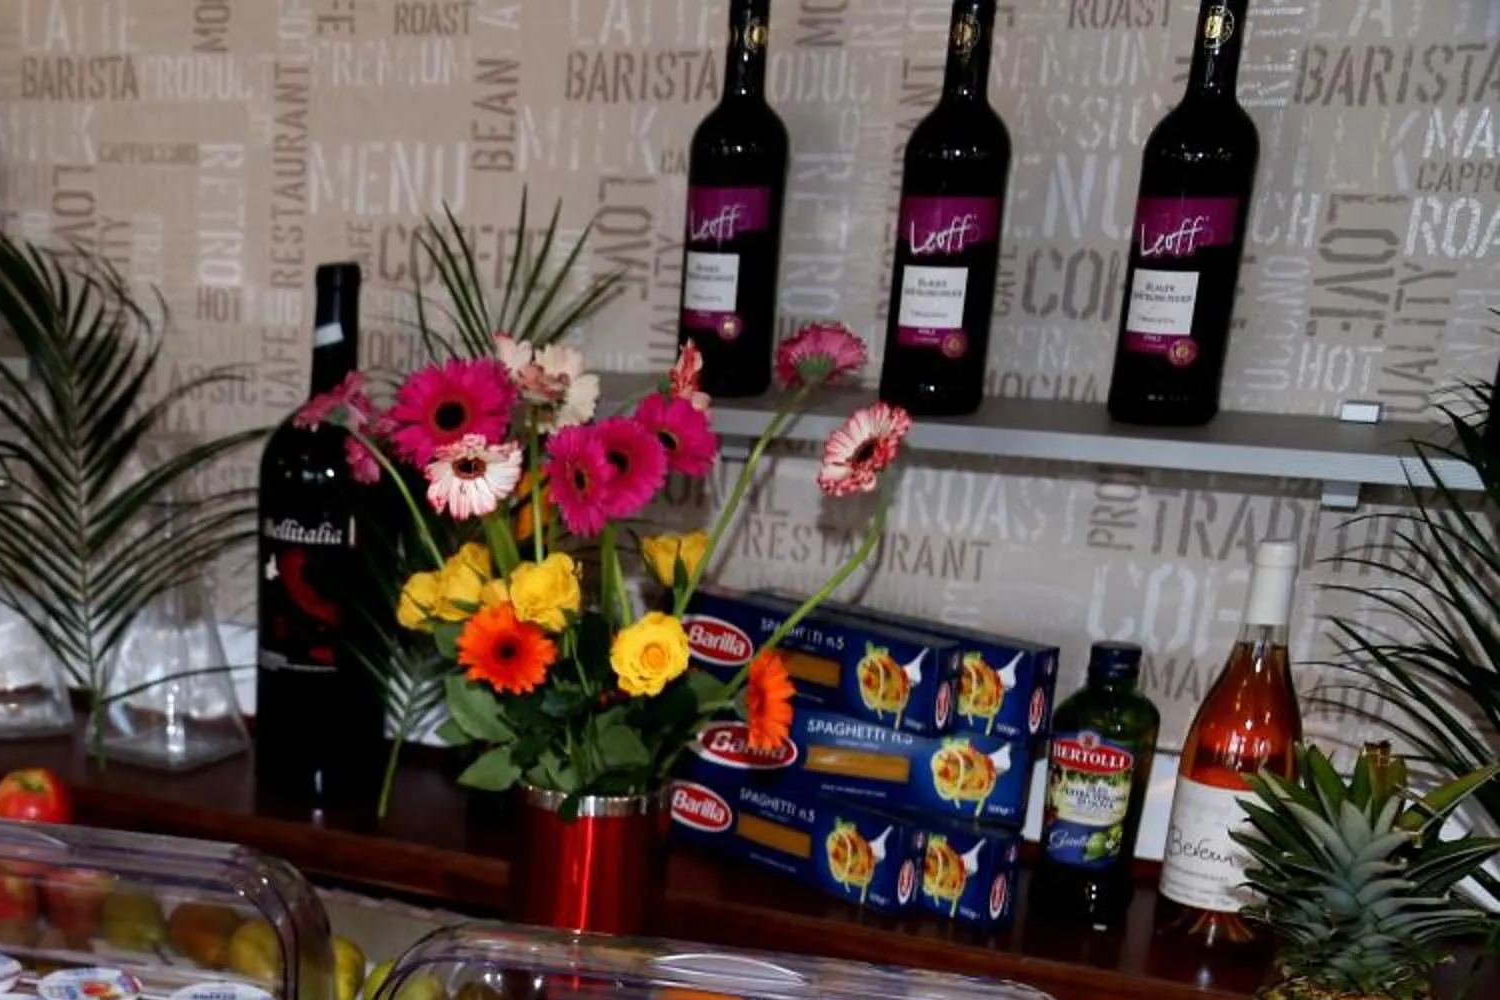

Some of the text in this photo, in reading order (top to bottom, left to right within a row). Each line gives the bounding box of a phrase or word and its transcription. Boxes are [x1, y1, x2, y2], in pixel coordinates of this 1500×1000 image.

[393, 0, 472, 36] ROAST
[20, 55, 140, 102] BARISTA
[564, 48, 720, 104] BARISTA
[468, 55, 521, 173] BEAN
[268, 59, 310, 289] RESTAURANT
[307, 140, 469, 217] MENU
[1403, 195, 1500, 259] ROA
[1305, 193, 1409, 341] LOVE
[196, 286, 244, 323] HOT
[1296, 342, 1387, 394] HOT
[897, 467, 1080, 547] ROAST
[741, 515, 992, 583] RESTARANT
[688, 622, 747, 658] Barilla
[806, 718, 888, 742] SPAGHETTI
[1052, 743, 1126, 769] BERTOLLI
[671, 787, 727, 825] Barilla
[739, 786, 797, 817] SPAGHETTI
